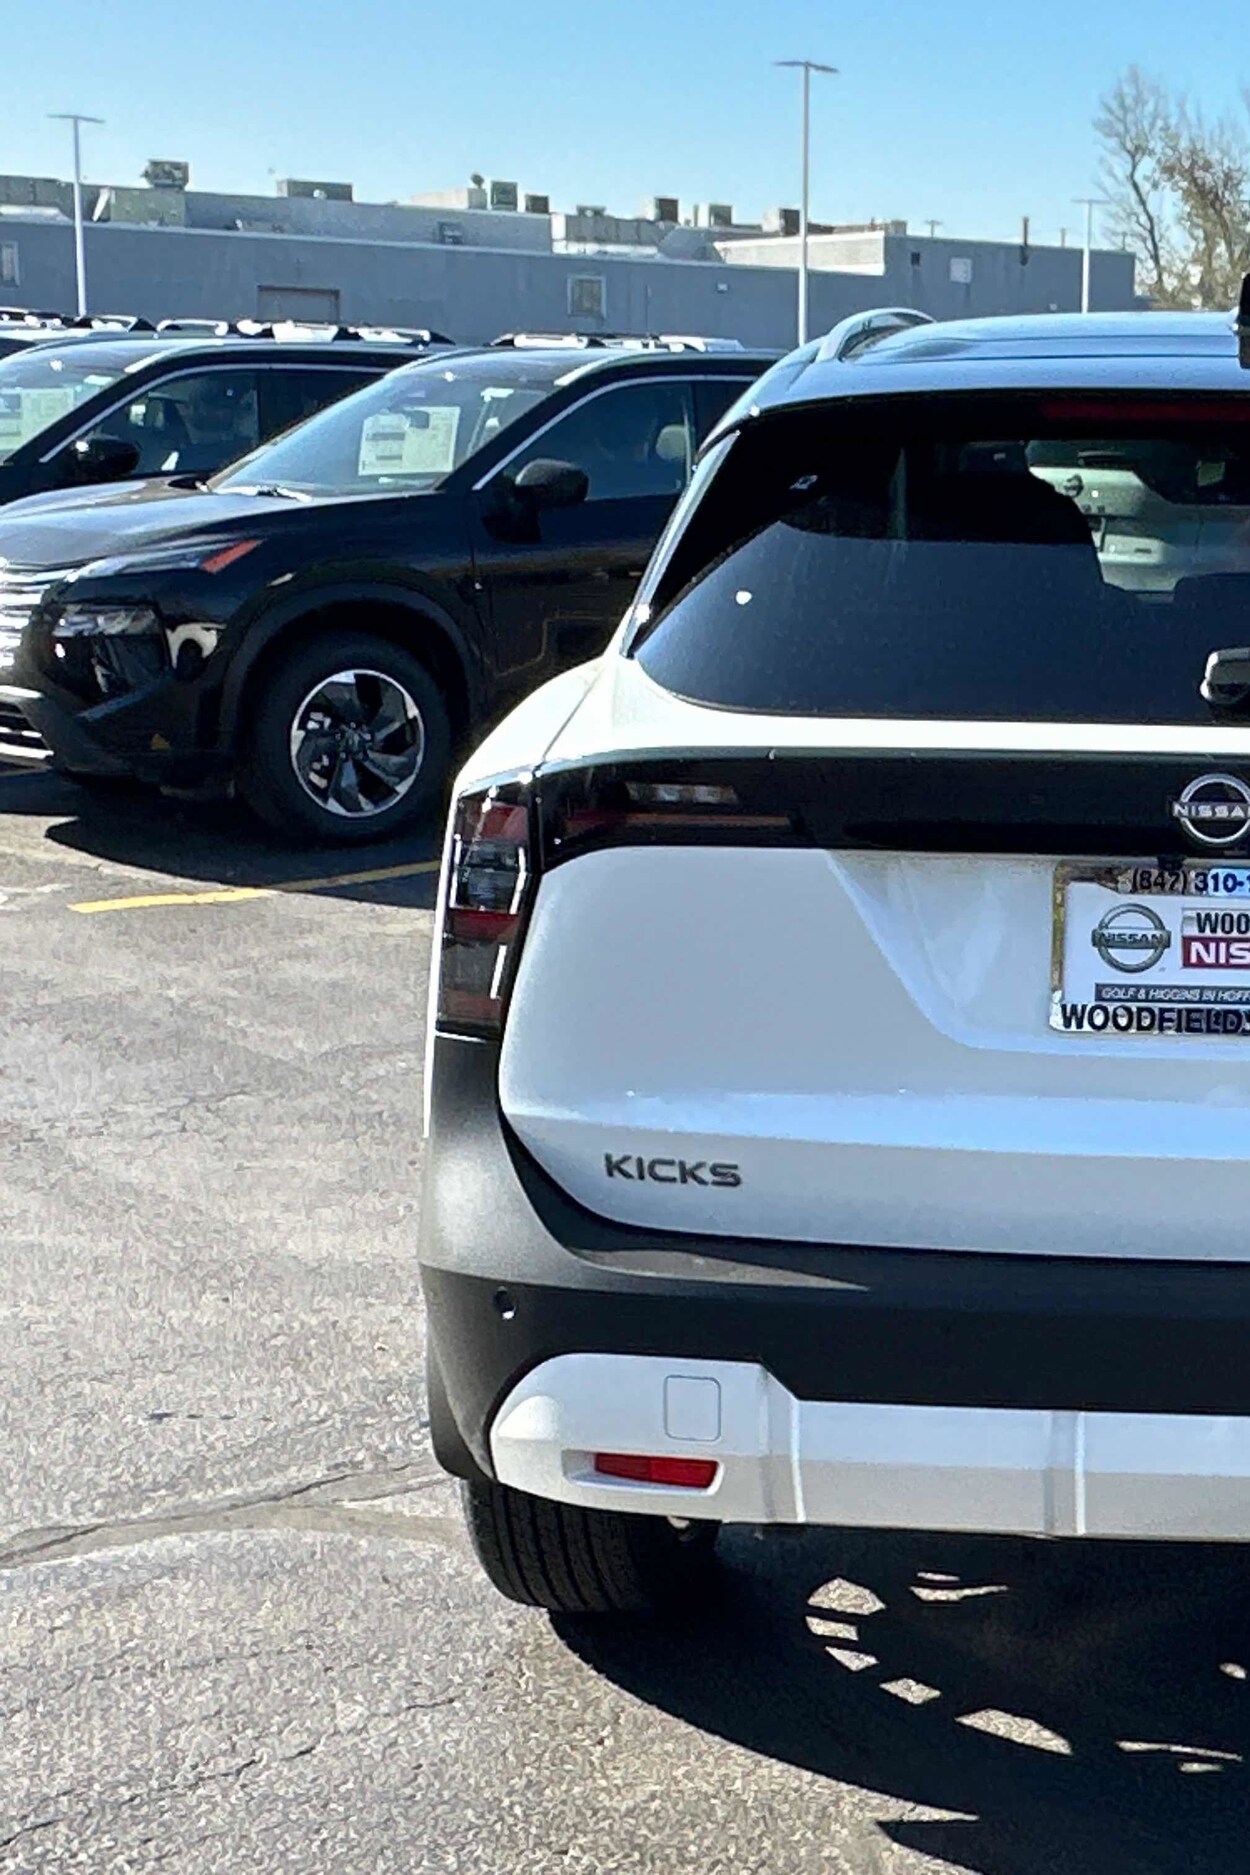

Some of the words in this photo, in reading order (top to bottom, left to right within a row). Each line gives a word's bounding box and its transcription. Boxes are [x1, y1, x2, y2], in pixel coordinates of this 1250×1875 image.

[1132, 869, 1187, 895] (847)
[1098, 931, 1164, 945] NISSAN
[1102, 987, 1137, 1000] GOLF
[604, 1152, 743, 1187] KICKS
